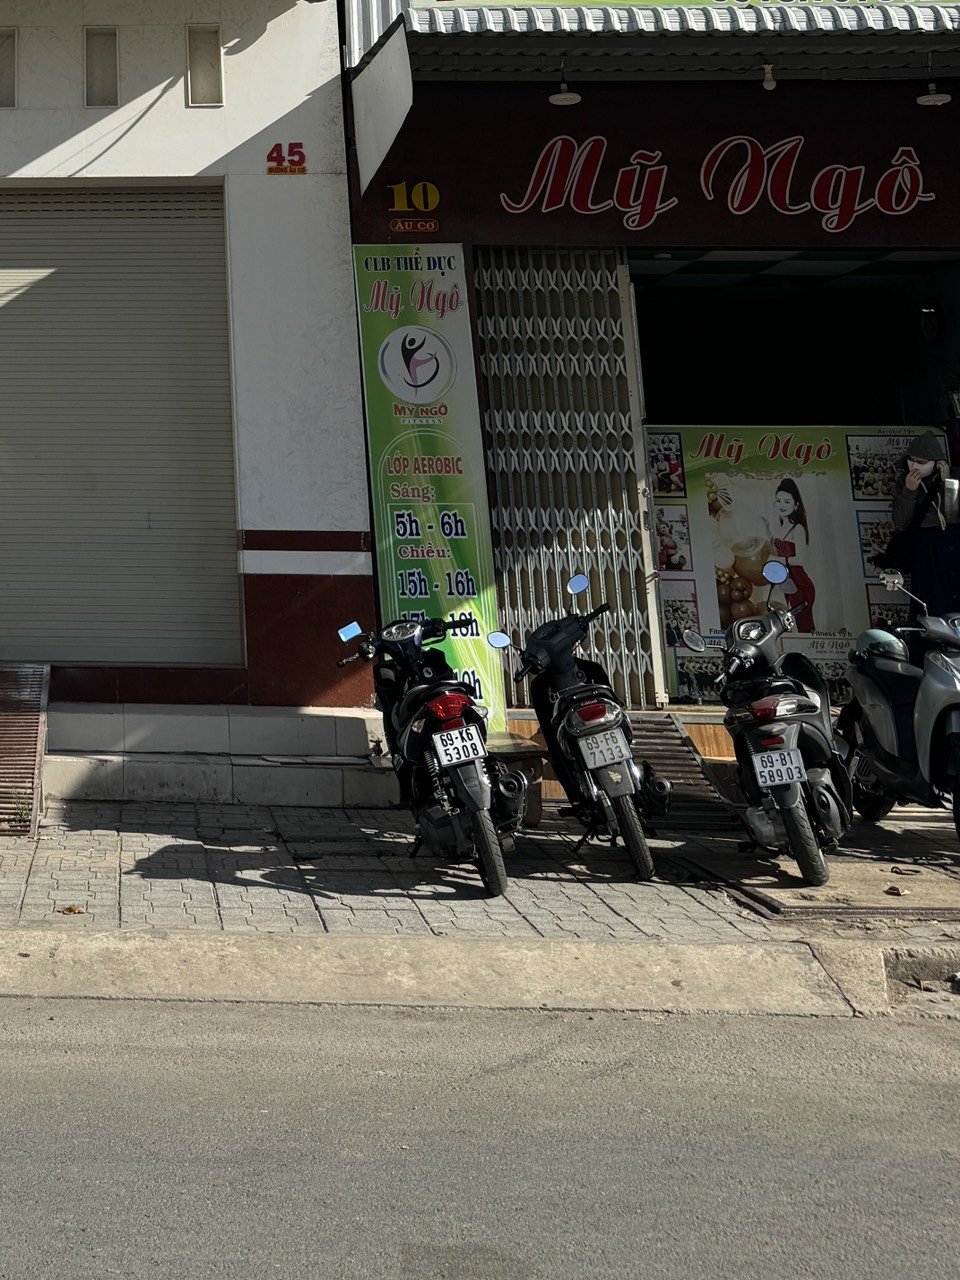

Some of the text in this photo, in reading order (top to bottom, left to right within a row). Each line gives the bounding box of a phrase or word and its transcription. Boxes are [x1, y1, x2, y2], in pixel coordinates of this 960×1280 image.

[267, 143, 305, 166] 45
[499, 135, 936, 233] Mỹ Ngô
[387, 181, 440, 212] 10
[395, 220, 436, 230] ÂU CƠ
[364, 246, 456, 276] CLB THỂ DỤC
[363, 279, 464, 319] Mỹ Ngô
[420, 402, 448, 417] NGÔ
[689, 432, 837, 466] Mỹ Ngô
[386, 452, 464, 475] LỚP AEROBIC
[390, 482, 436, 503] Sáng:
[394, 510, 421, 539] 5h
[440, 510, 468, 539] 6h
[398, 541, 452, 559] Chiều:
[397, 568, 430, 598] 15h
[445, 569, 478, 597] 16h
[439, 727, 474, 748] 69-K6
[586, 731, 619, 751] 69-F6
[444, 742, 480, 763] 5308
[590, 745, 625, 766] 7133
[760, 751, 794, 769] 69-B1
[759, 766, 803, 784] 589.03
